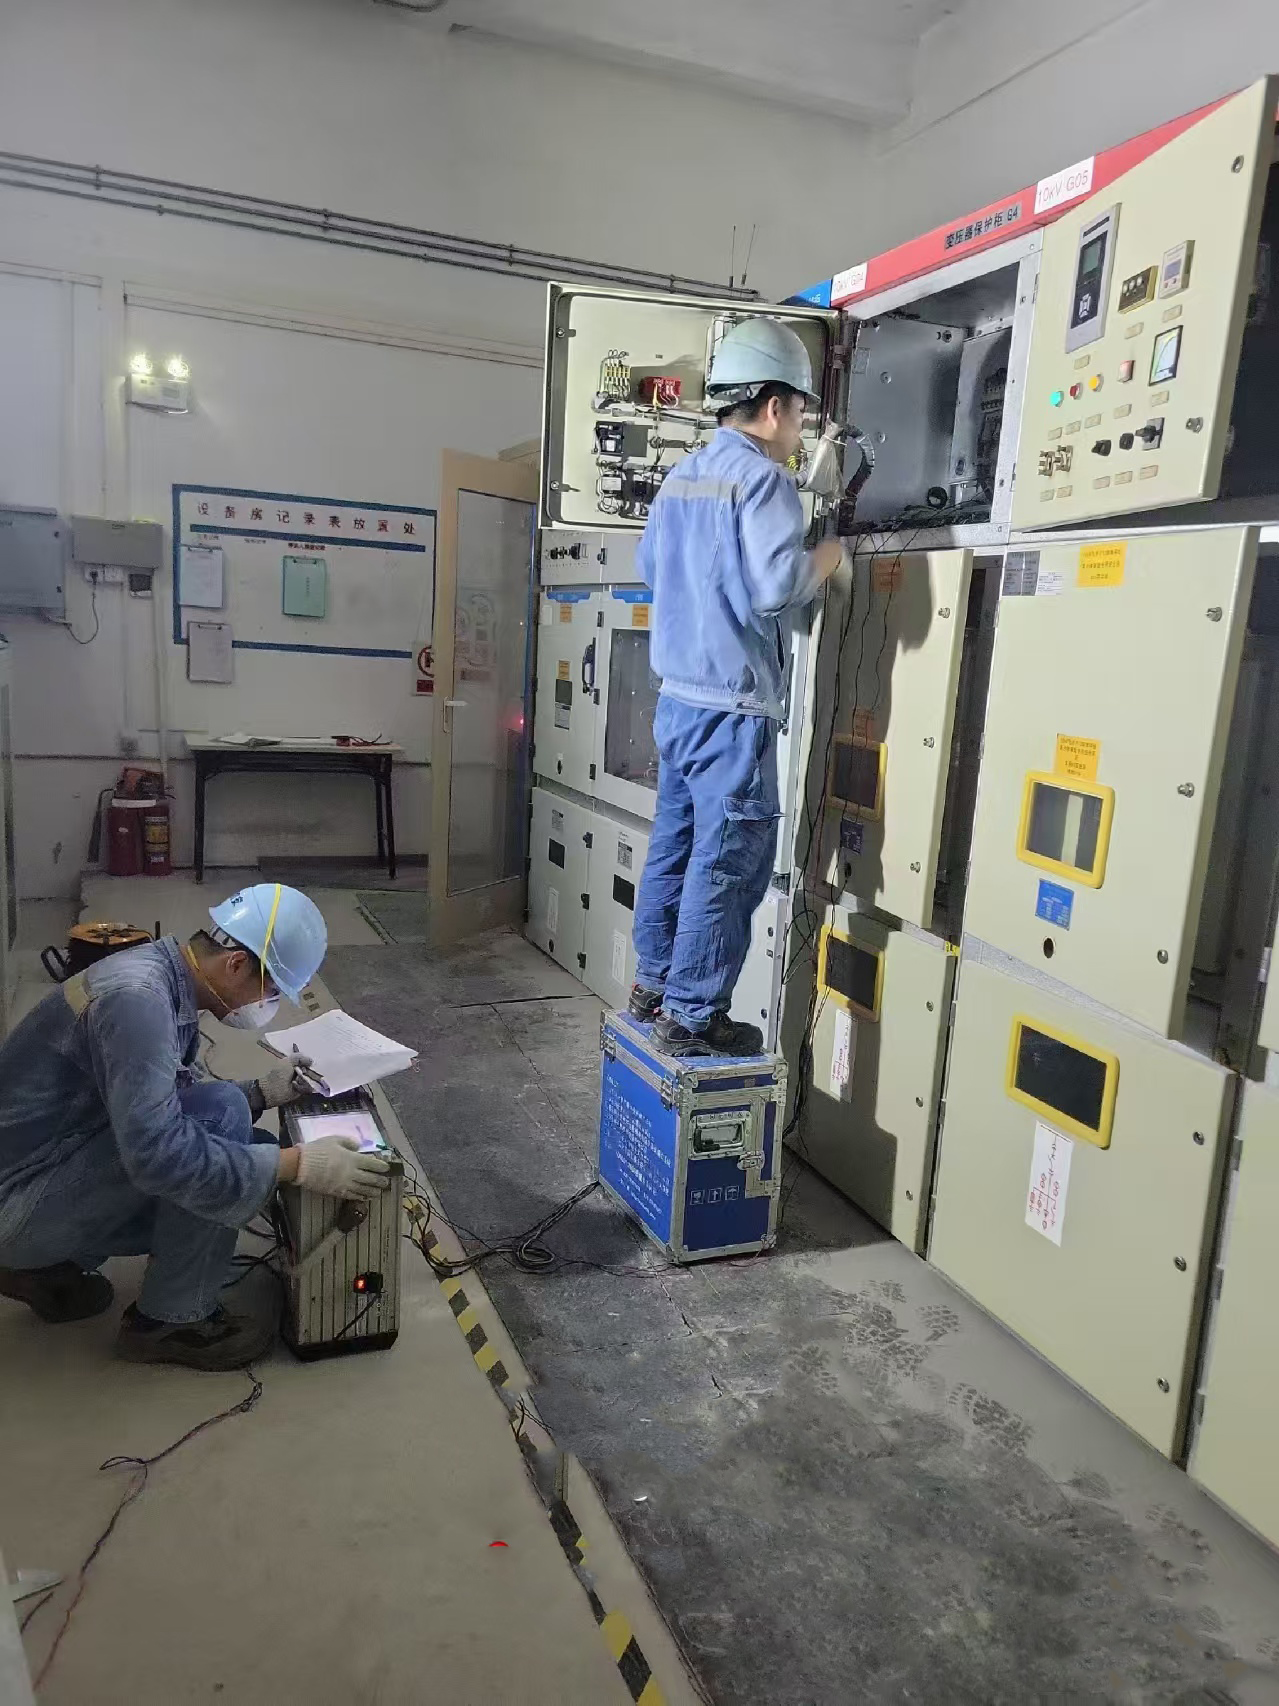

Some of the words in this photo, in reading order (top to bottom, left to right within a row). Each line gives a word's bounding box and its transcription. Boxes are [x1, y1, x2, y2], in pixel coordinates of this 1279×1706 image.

[1066, 169, 1089, 192] G05
[945, 211, 1004, 250] 变压器保护柜
[198, 502, 416, 534] 设备房记录表放置处
